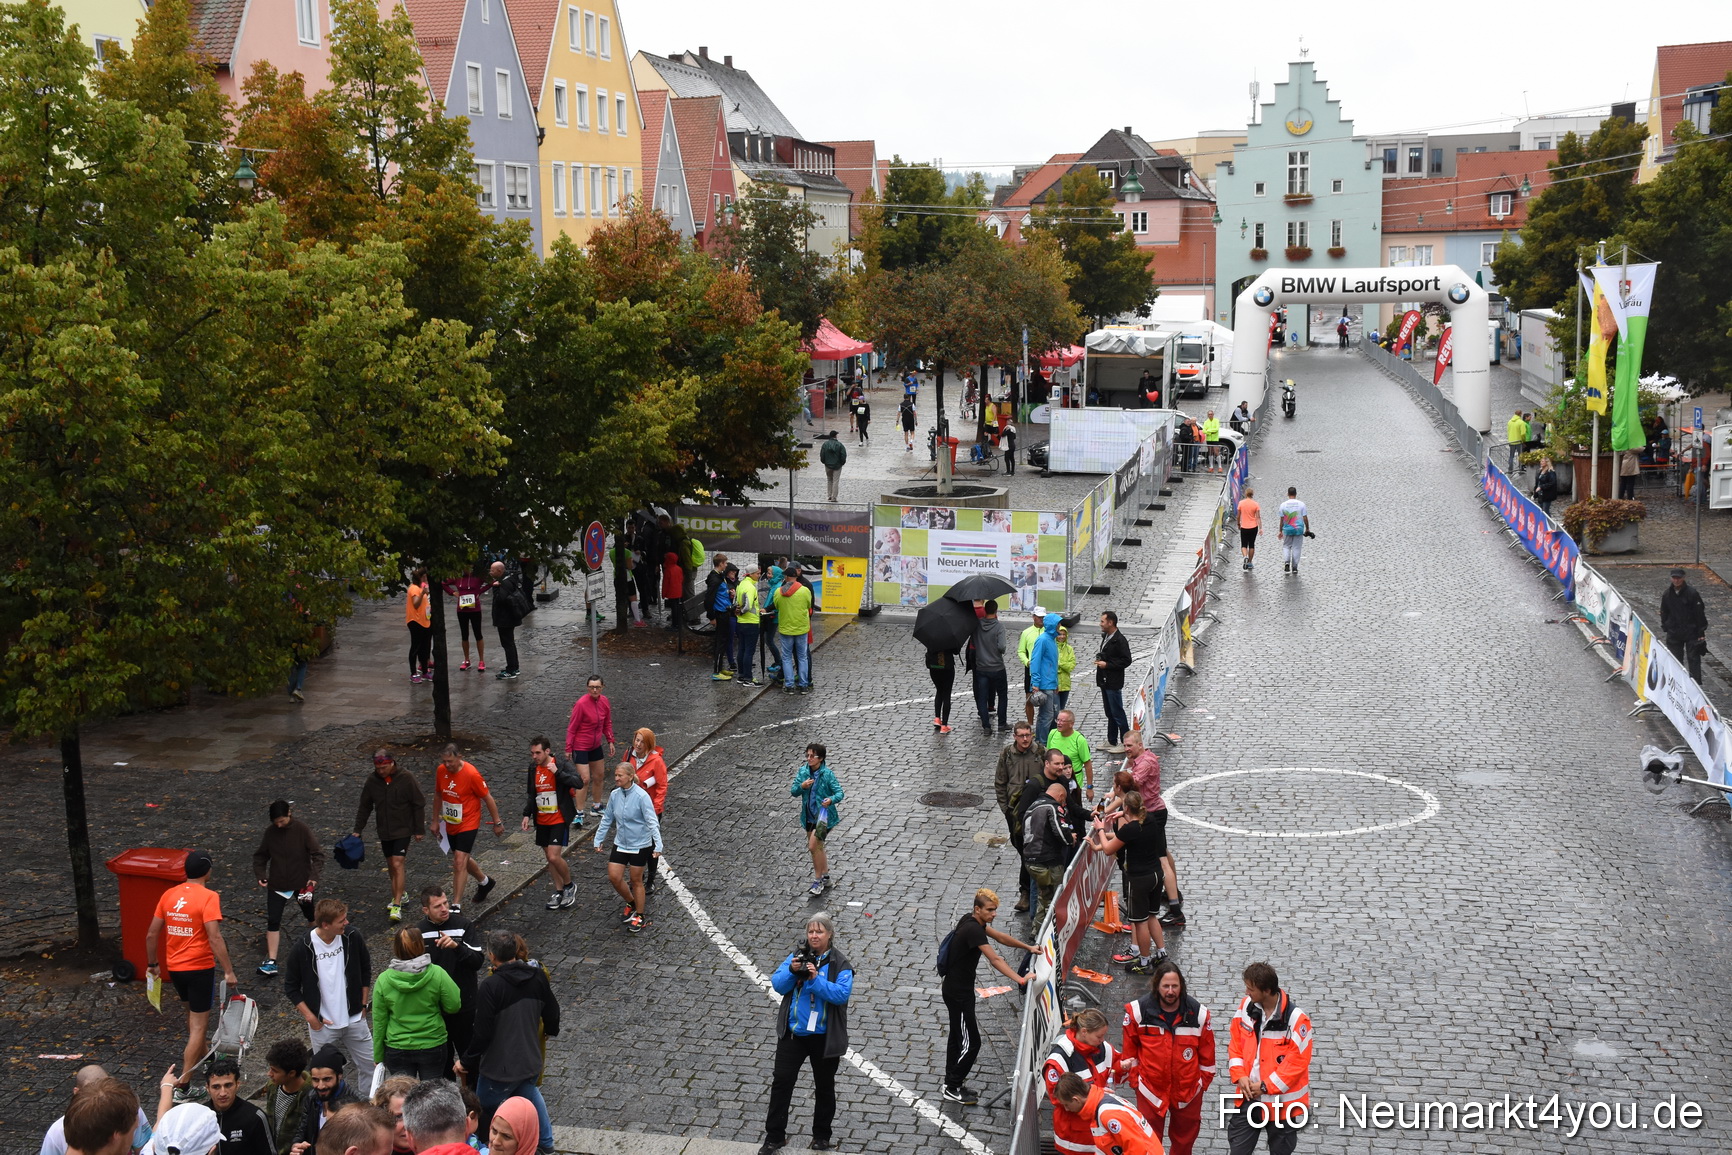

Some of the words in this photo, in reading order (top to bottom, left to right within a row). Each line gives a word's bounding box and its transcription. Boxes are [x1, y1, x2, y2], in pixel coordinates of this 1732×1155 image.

[1281, 277, 1337, 294] BMW
[1341, 276, 1441, 296] Laufsport
[1399, 313, 1418, 341] REWE
[1437, 331, 1453, 366] REW
[676, 517, 737, 532] BOCK
[752, 520, 783, 530] OFFICE
[832, 525, 870, 534] LOUNGE
[769, 533, 853, 545] wwwbockonline.de
[937, 557, 968, 568] Neuer
[970, 558, 1000, 569] Markt
[541, 797, 550, 806] 71
[445, 807, 458, 818] 330
